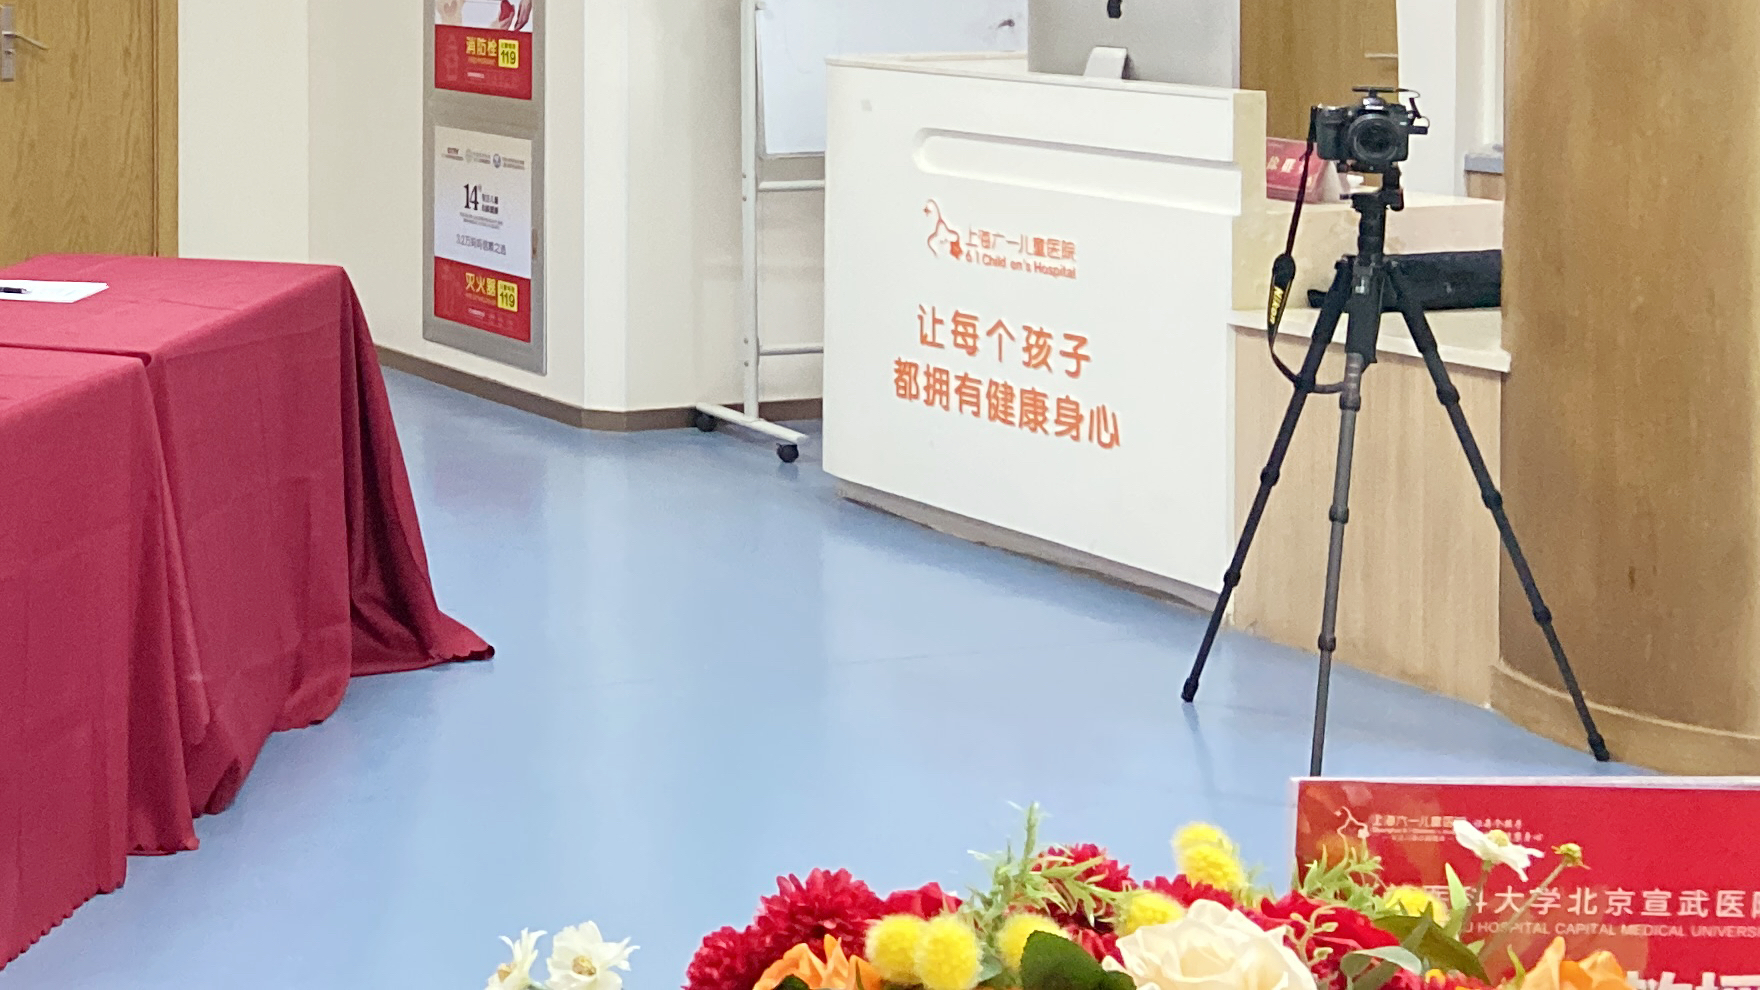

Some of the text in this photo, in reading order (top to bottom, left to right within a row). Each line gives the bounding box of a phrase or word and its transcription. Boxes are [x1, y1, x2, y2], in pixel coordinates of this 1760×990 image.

[466, 36, 497, 57] 消防栓
[500, 50, 516, 65] 119
[464, 183, 479, 211] 14
[1033, 260, 1077, 279] Hospital
[465, 272, 496, 296] 灭火器
[500, 292, 515, 308] 119
[917, 303, 1092, 379] 让每个孩子
[893, 356, 1121, 449] 都拥有健康身心
[1371, 814, 1467, 828] 上海六一儿童医
[1555, 922, 1616, 937] CAPITAL
[1621, 923, 1684, 937] MEDICAL
